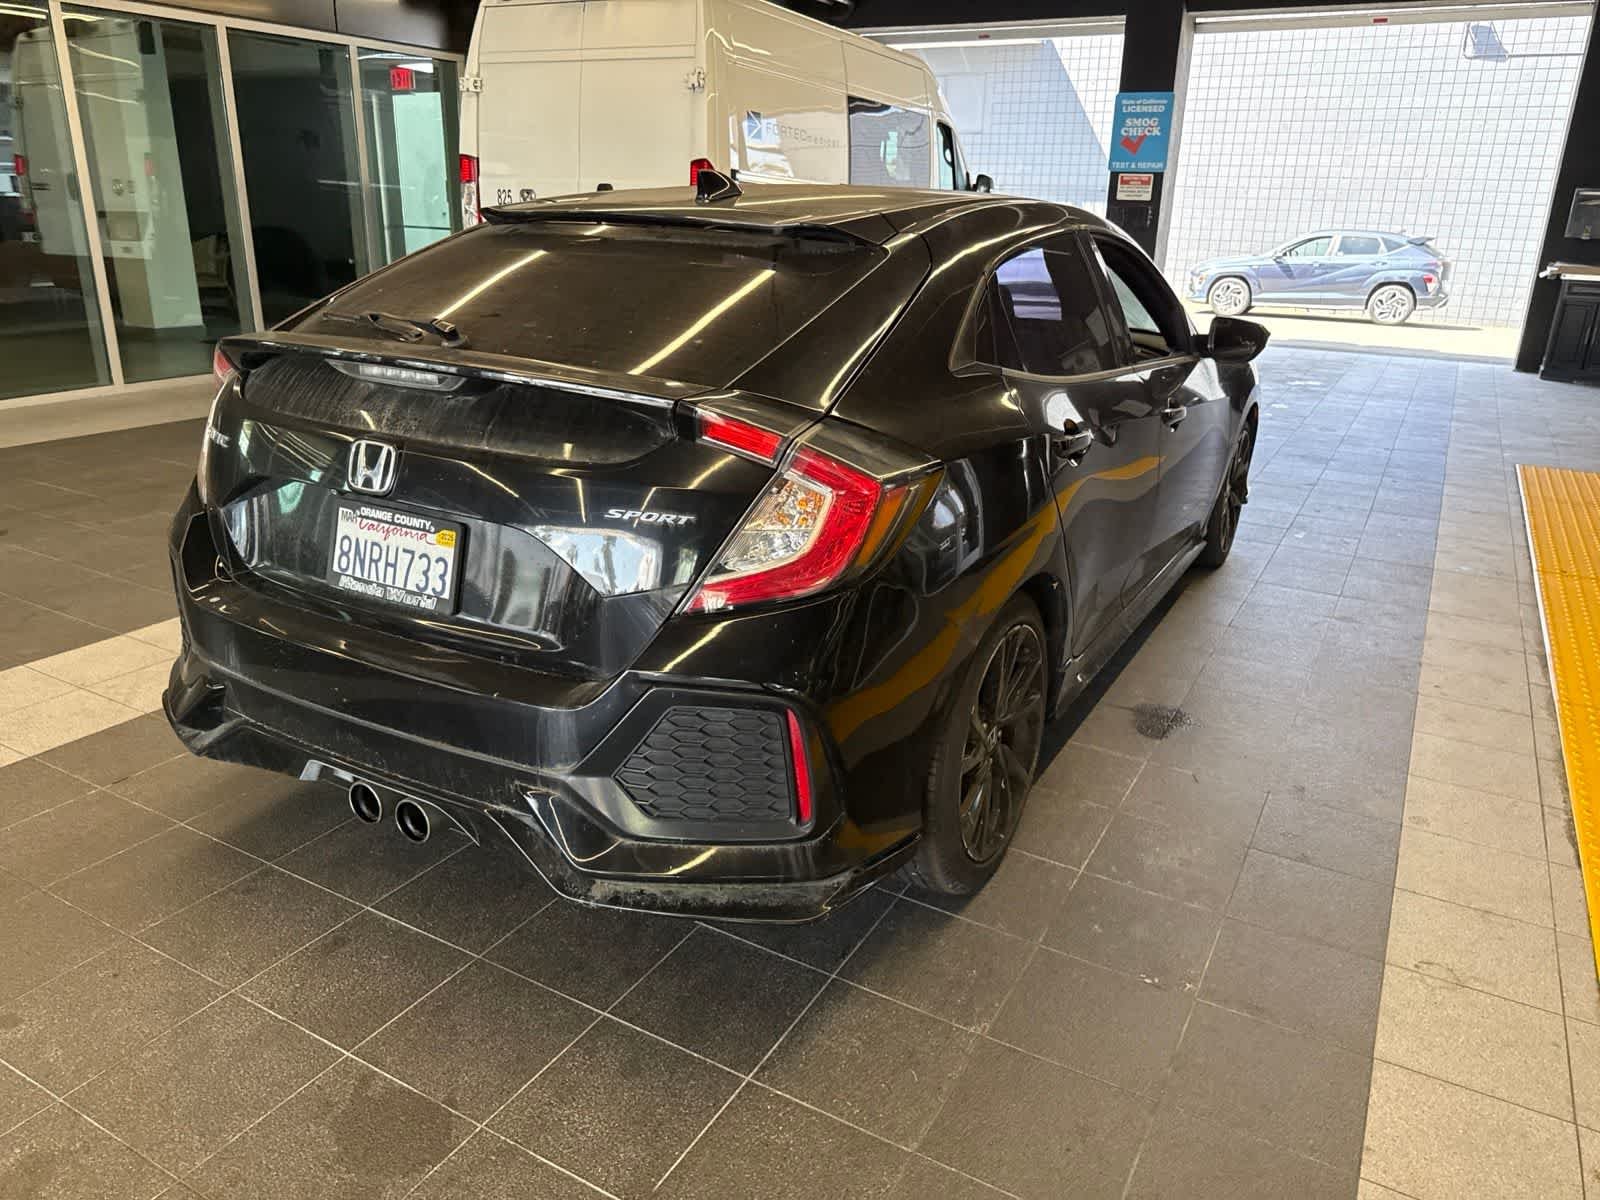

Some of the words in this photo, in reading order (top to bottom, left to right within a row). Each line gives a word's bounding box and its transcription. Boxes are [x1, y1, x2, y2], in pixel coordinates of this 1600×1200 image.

[1125, 118, 1159, 126] SMOG
[1120, 127, 1161, 136] CHECK
[1111, 161, 1129, 169] TEST
[1130, 161, 1137, 169] &
[1138, 161, 1164, 169] REPAIR
[497, 188, 513, 205] 825
[360, 506, 393, 522] ORANGE
[604, 508, 697, 526] SPORT
[337, 534, 449, 597] 8NRH733
